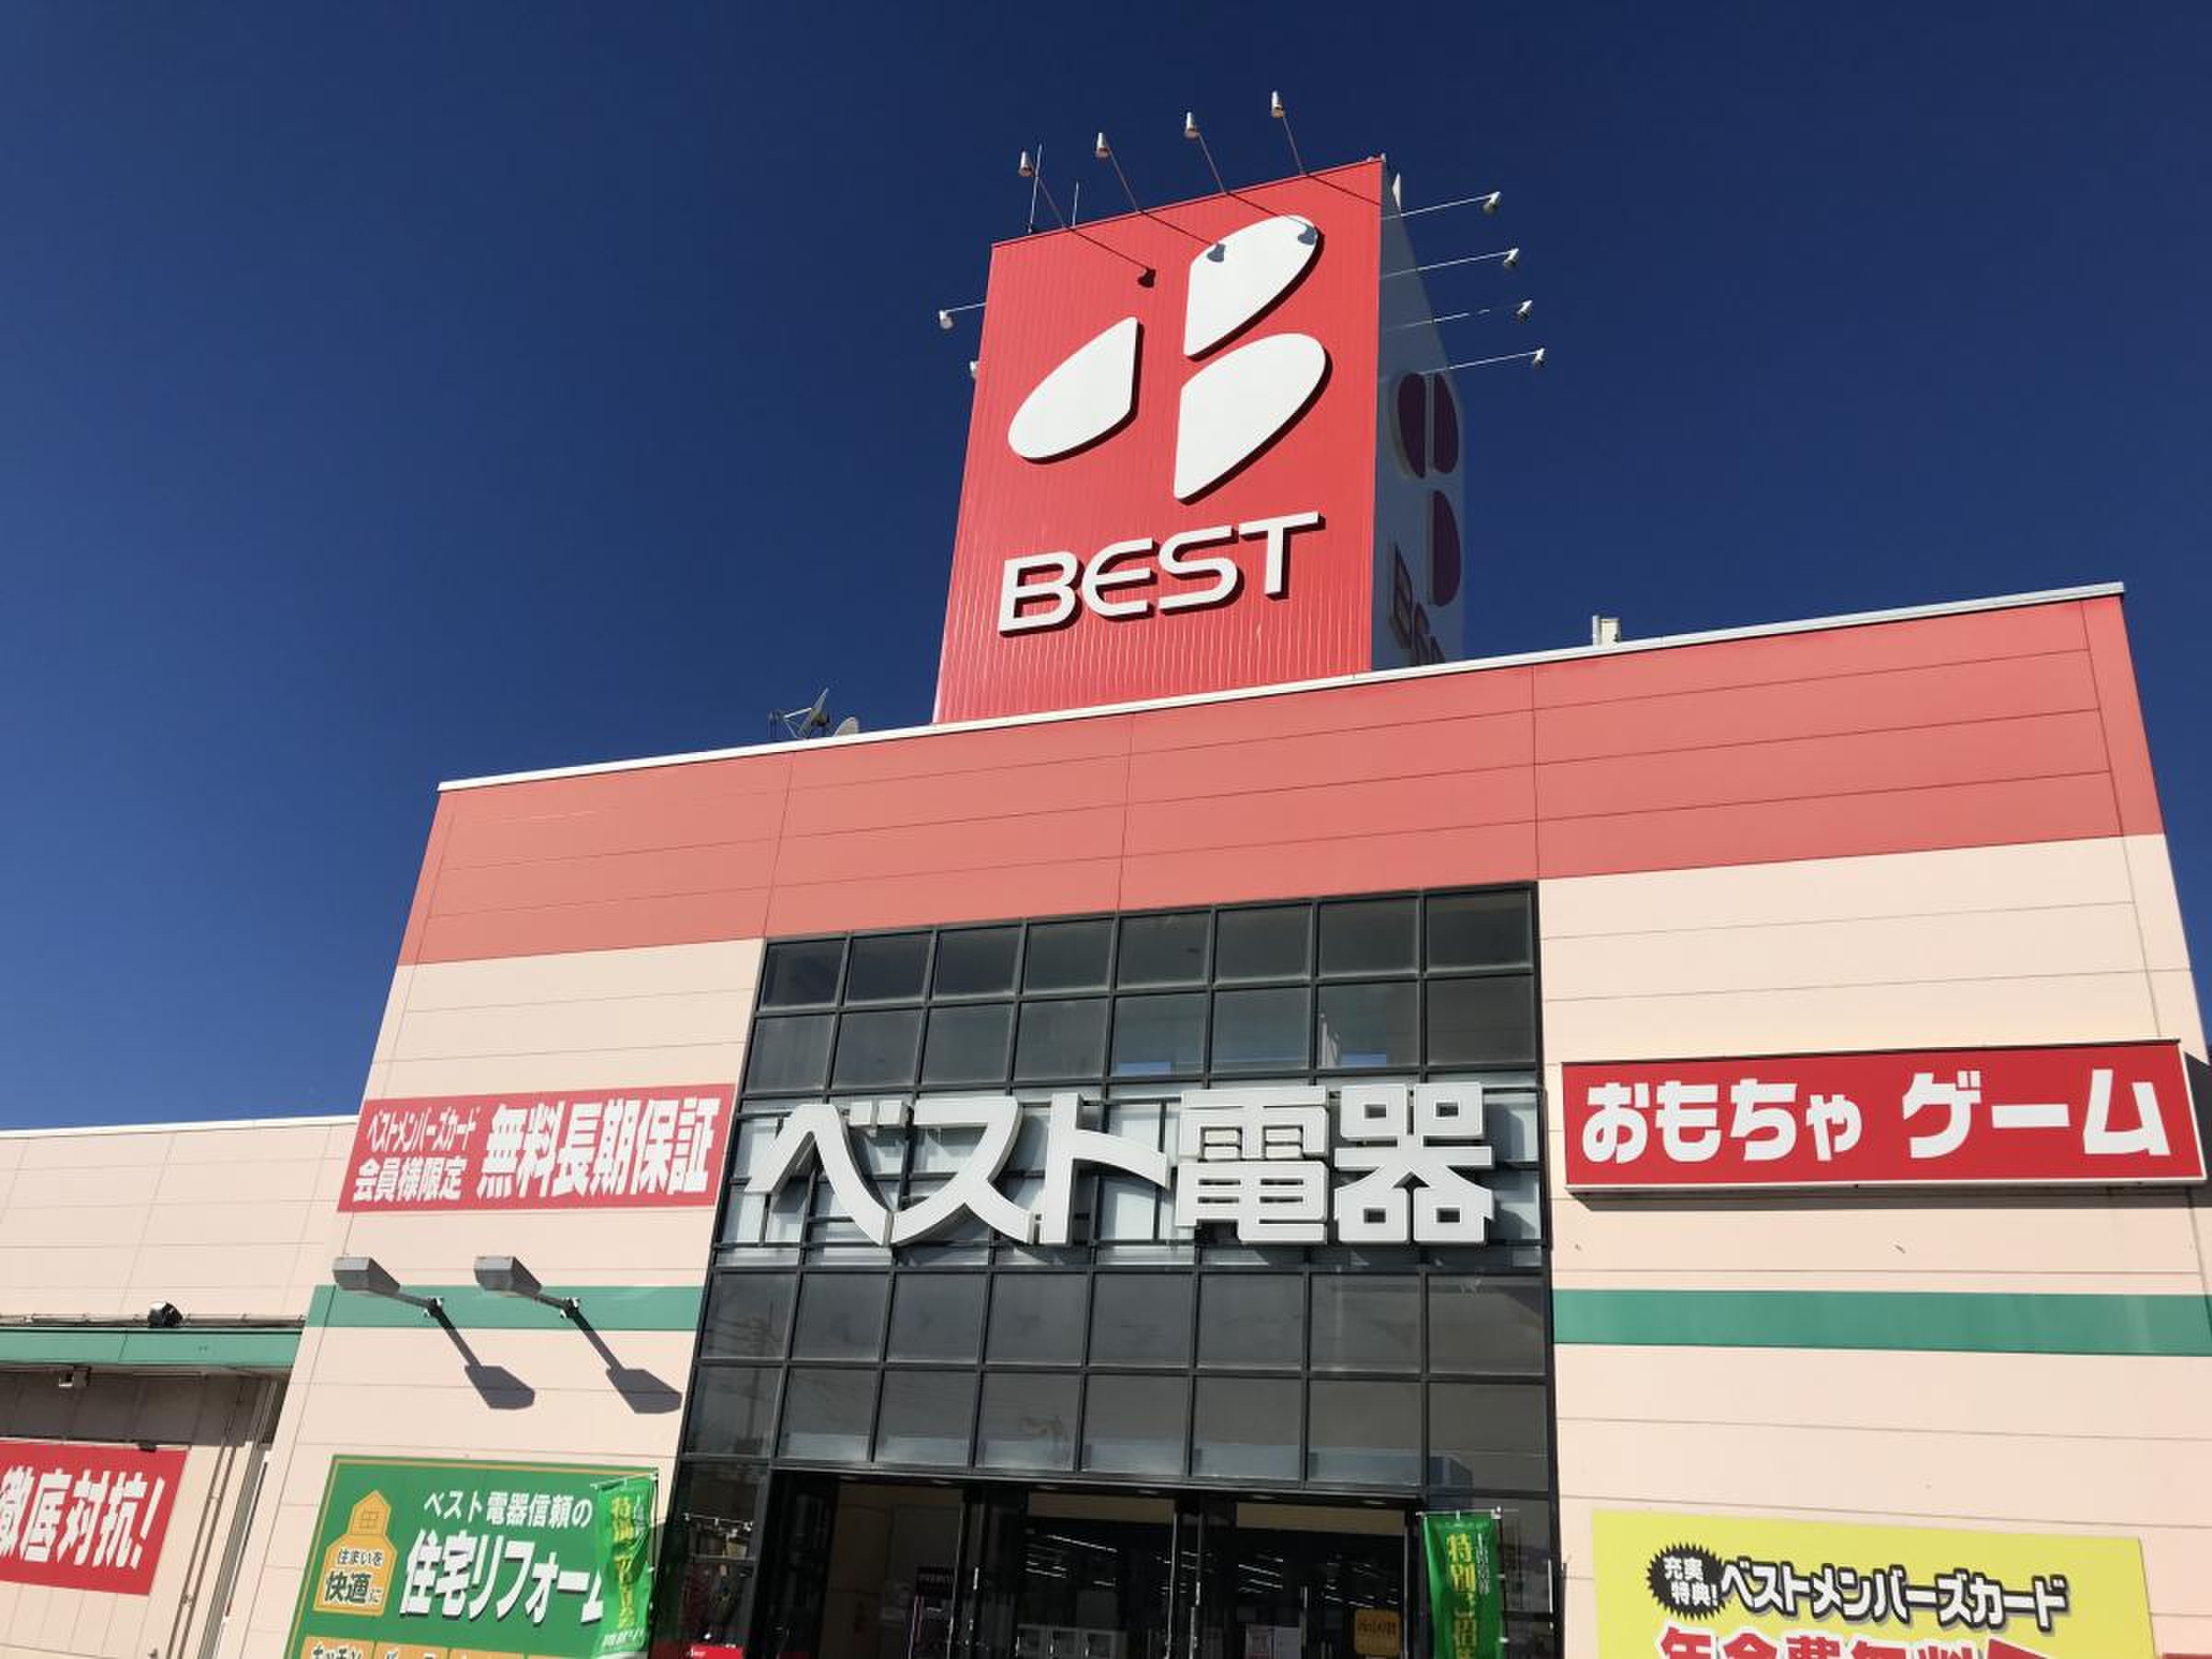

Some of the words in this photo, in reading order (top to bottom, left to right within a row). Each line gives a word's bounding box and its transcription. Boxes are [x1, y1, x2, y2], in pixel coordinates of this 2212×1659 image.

[998, 511, 1323, 634] BEST
[367, 1105, 479, 1153] ベストメンバーズカード
[1582, 1077, 1862, 1163] おもちゃ
[1901, 1068, 2171, 1159] ゲーム
[477, 1097, 721, 1198] 無料長期保証
[743, 1082, 1495, 1249] ベスト電器
[353, 1156, 468, 1203] 会員様限定
[337, 1548, 383, 1567] 住まいを
[1664, 1556, 1704, 1581] 充実
[324, 1571, 383, 1604] 快適に
[1669, 1582, 1719, 1607] 特典!
[1722, 1558, 2067, 1630] ベストメンバーズカード
